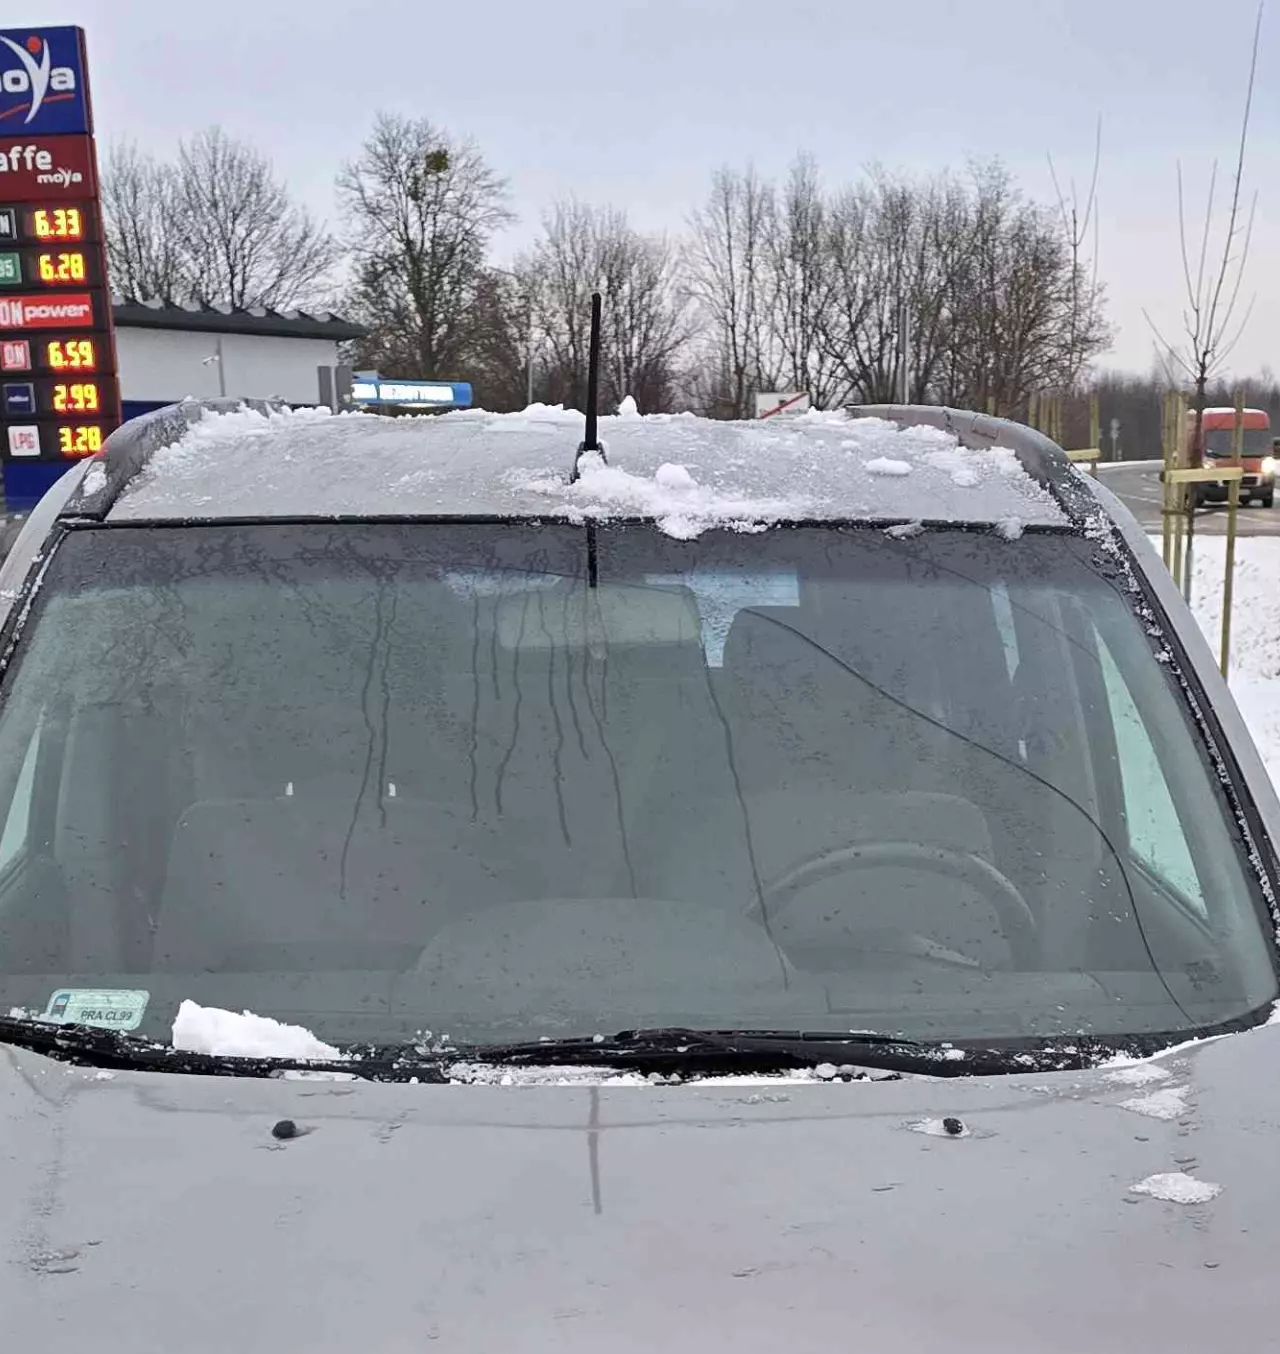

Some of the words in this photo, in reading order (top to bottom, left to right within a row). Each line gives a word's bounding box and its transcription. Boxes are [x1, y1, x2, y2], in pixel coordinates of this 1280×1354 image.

[36, 167, 82, 188] moya
[35, 209, 80, 236] 6.33
[39, 253, 84, 280] 6.28
[24, 304, 90, 322] power
[4, 344, 25, 366] ON
[48, 341, 93, 367] 6.59
[53, 384, 98, 410] 2.99
[58, 425, 102, 453] 3.28
[80, 1010, 102, 1021] PRA
[105, 1010, 132, 1021] CL99
